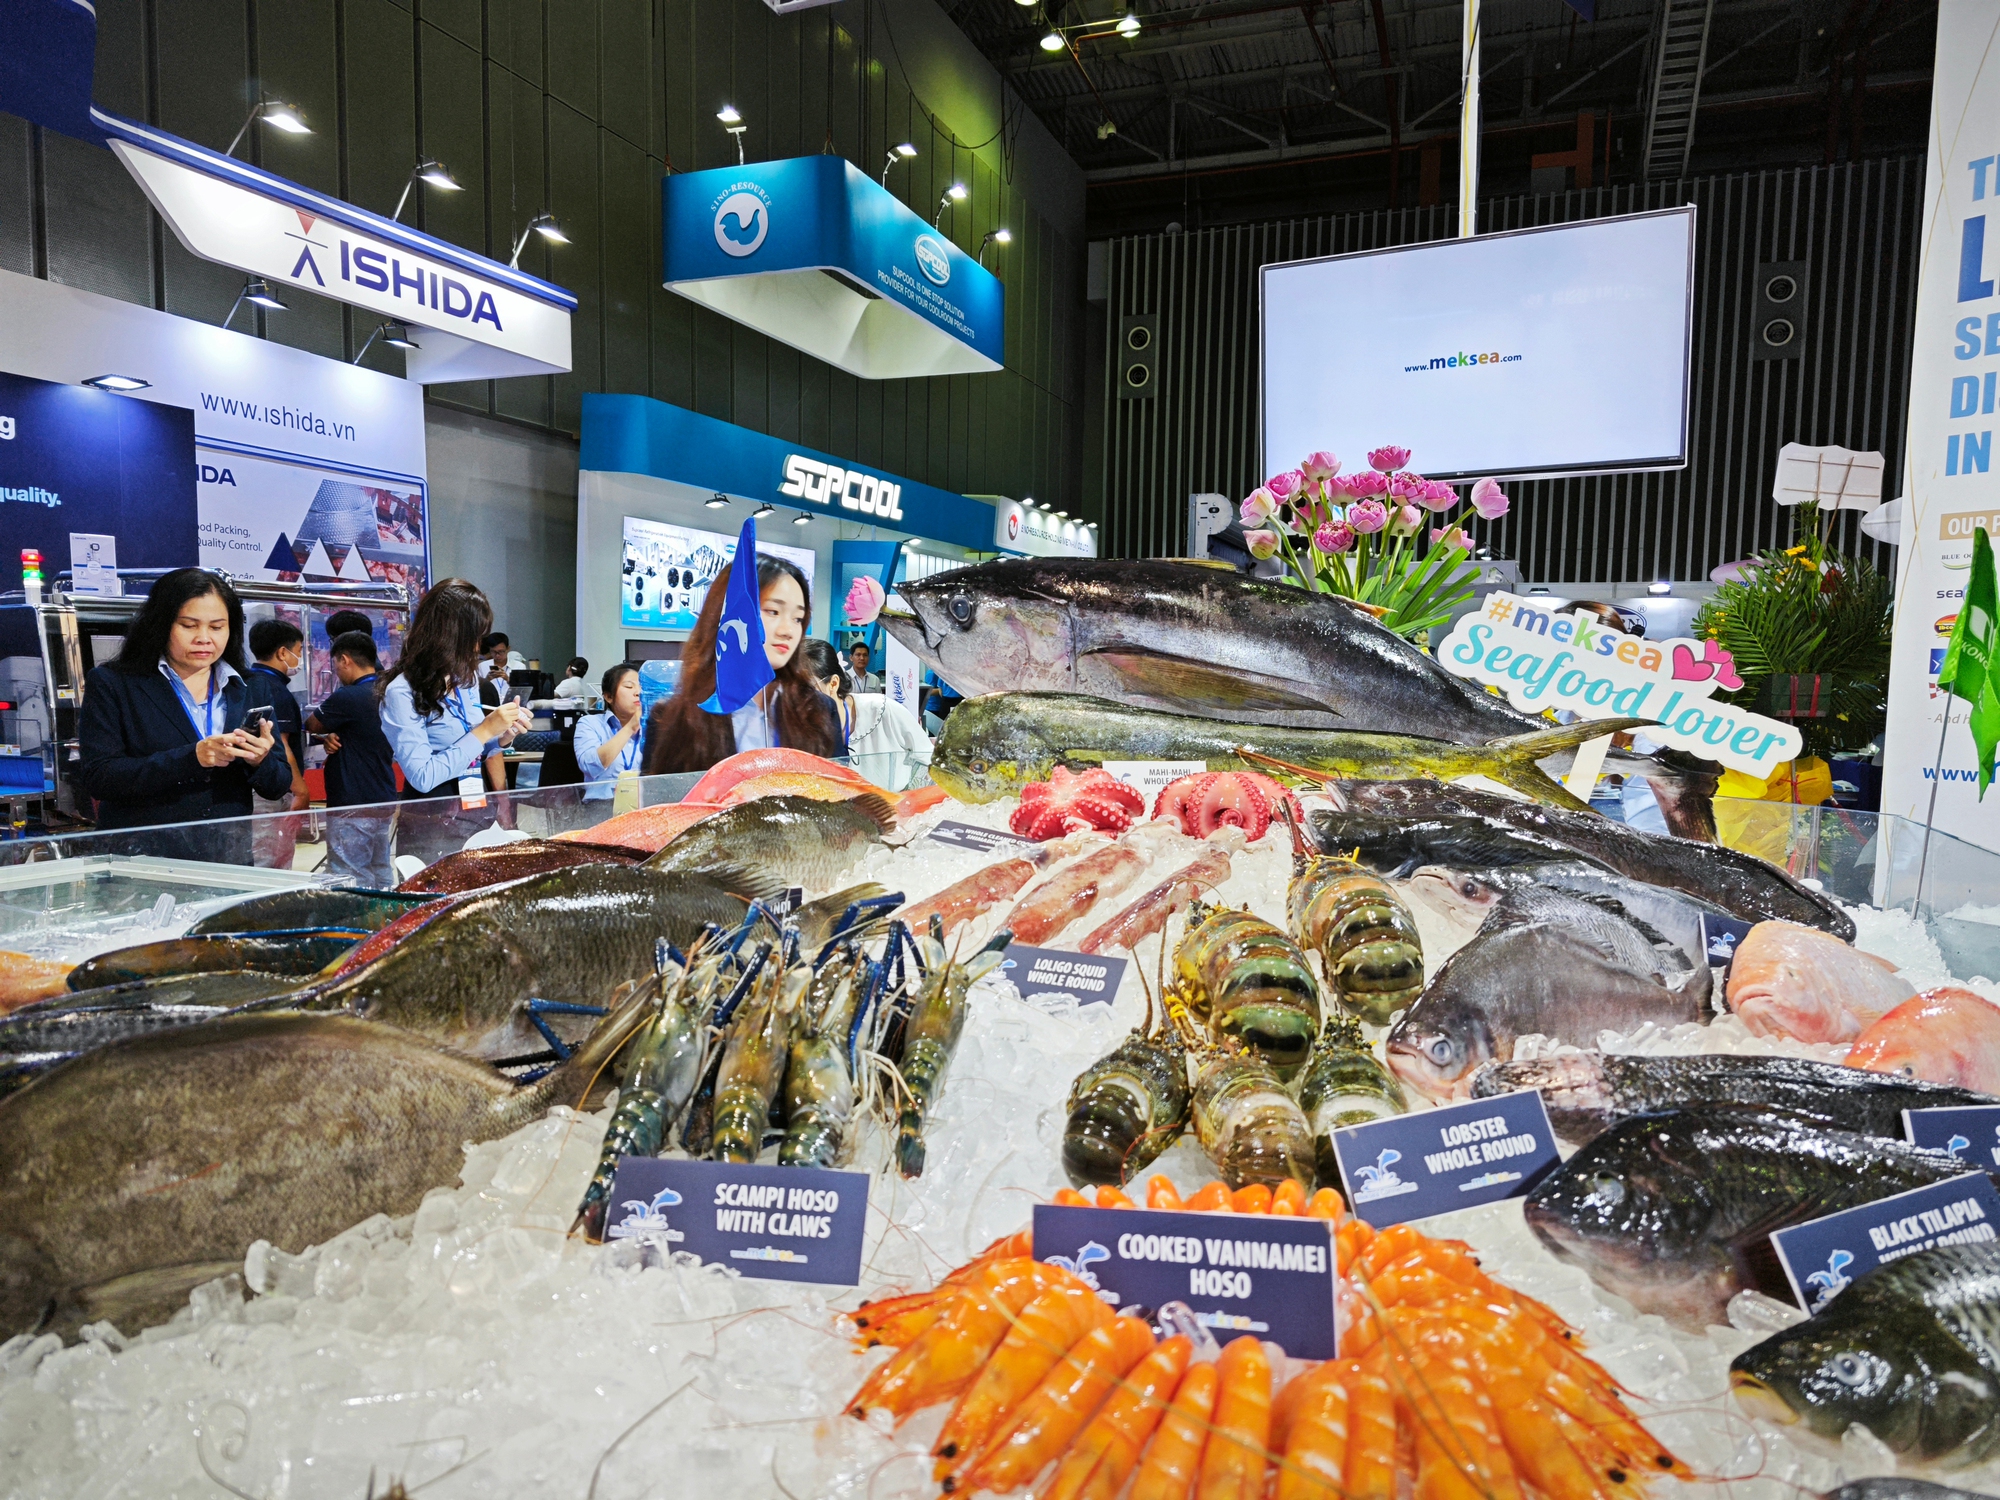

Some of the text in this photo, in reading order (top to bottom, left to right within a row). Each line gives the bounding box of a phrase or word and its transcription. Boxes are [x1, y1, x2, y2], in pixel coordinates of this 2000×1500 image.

[1967, 154, 2000, 202] T
[711, 181, 773, 212] SINO-RESOURCE
[918, 245, 950, 275] SUPCOOL
[1957, 214, 2000, 303] L
[340, 239, 503, 332] ISHIDA
[892, 265, 916, 289] SUPCOOL
[916, 281, 921, 292] IS
[921, 285, 932, 299] ONE
[931, 292, 944, 305] STOP
[943, 300, 965, 320] SOLUTION
[877, 269, 975, 339] PROVIDER FOR YOUR COOLROOM PROJECTS
[1404, 351, 1522, 372] www.meksea.com
[1949, 371, 2000, 419] DI
[201, 392, 355, 441] www.ishida.vn
[1945, 430, 1992, 477] IN
[780, 454, 903, 521] SUPCOOL
[214, 523, 251, 538] Packing,
[228, 540, 263, 552] Control.
[1488, 598, 1662, 673] #meksea
[1453, 624, 1787, 761] Seafood lover
[1143, 777, 1170, 785] WHOLE
[1148, 768, 1192, 776] MAHI-MAHI
[965, 828, 989, 838] WHOLE
[1027, 970, 1105, 992] WHOLE ROUND
[1034, 958, 1107, 978] LOLIGO SQUID
[1440, 1116, 1509, 1148] LOBSTER
[1424, 1133, 1537, 1175] WHOLE ROUND
[713, 1182, 839, 1213] SCAMPI HOSO
[716, 1208, 832, 1239] WITH CLAWS
[1868, 1197, 1985, 1251] BLACK TILAPIA
[1117, 1233, 1327, 1273] COOKED VANNAMEI
[1190, 1268, 1252, 1299] HOSO
